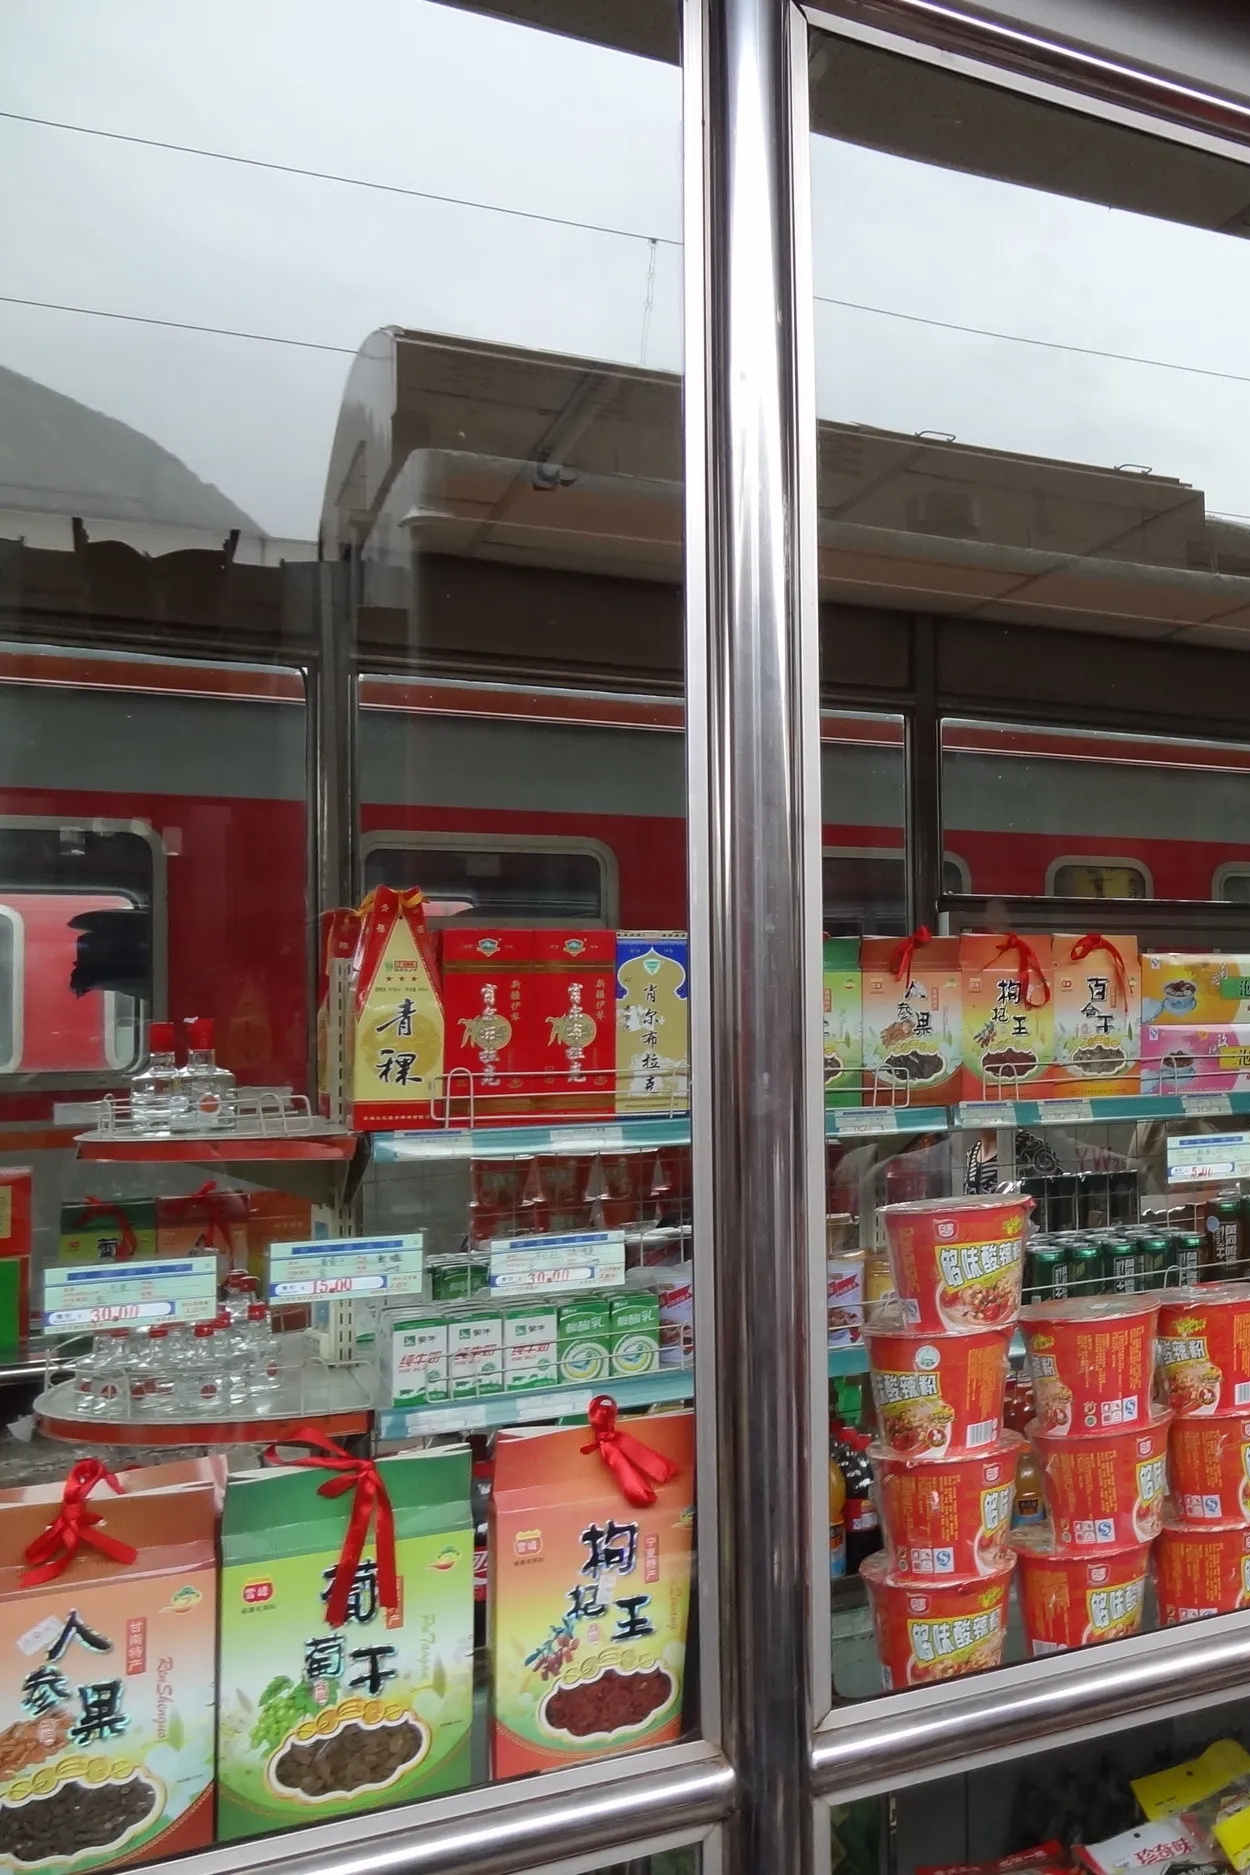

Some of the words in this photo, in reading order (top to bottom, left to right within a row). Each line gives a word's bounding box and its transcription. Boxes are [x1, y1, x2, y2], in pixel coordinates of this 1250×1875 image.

[896, 980, 933, 1037] 人参果
[1081, 978, 1116, 1034] 百合干
[376, 997, 424, 1087] 青稞
[641, 983, 661, 1094] 肖尔布拉克
[312, 1279, 353, 1295] 15.00
[528, 1269, 570, 1285] 30.00
[90, 1304, 139, 1324] 30.00
[20, 1605, 132, 1749] 人参果
